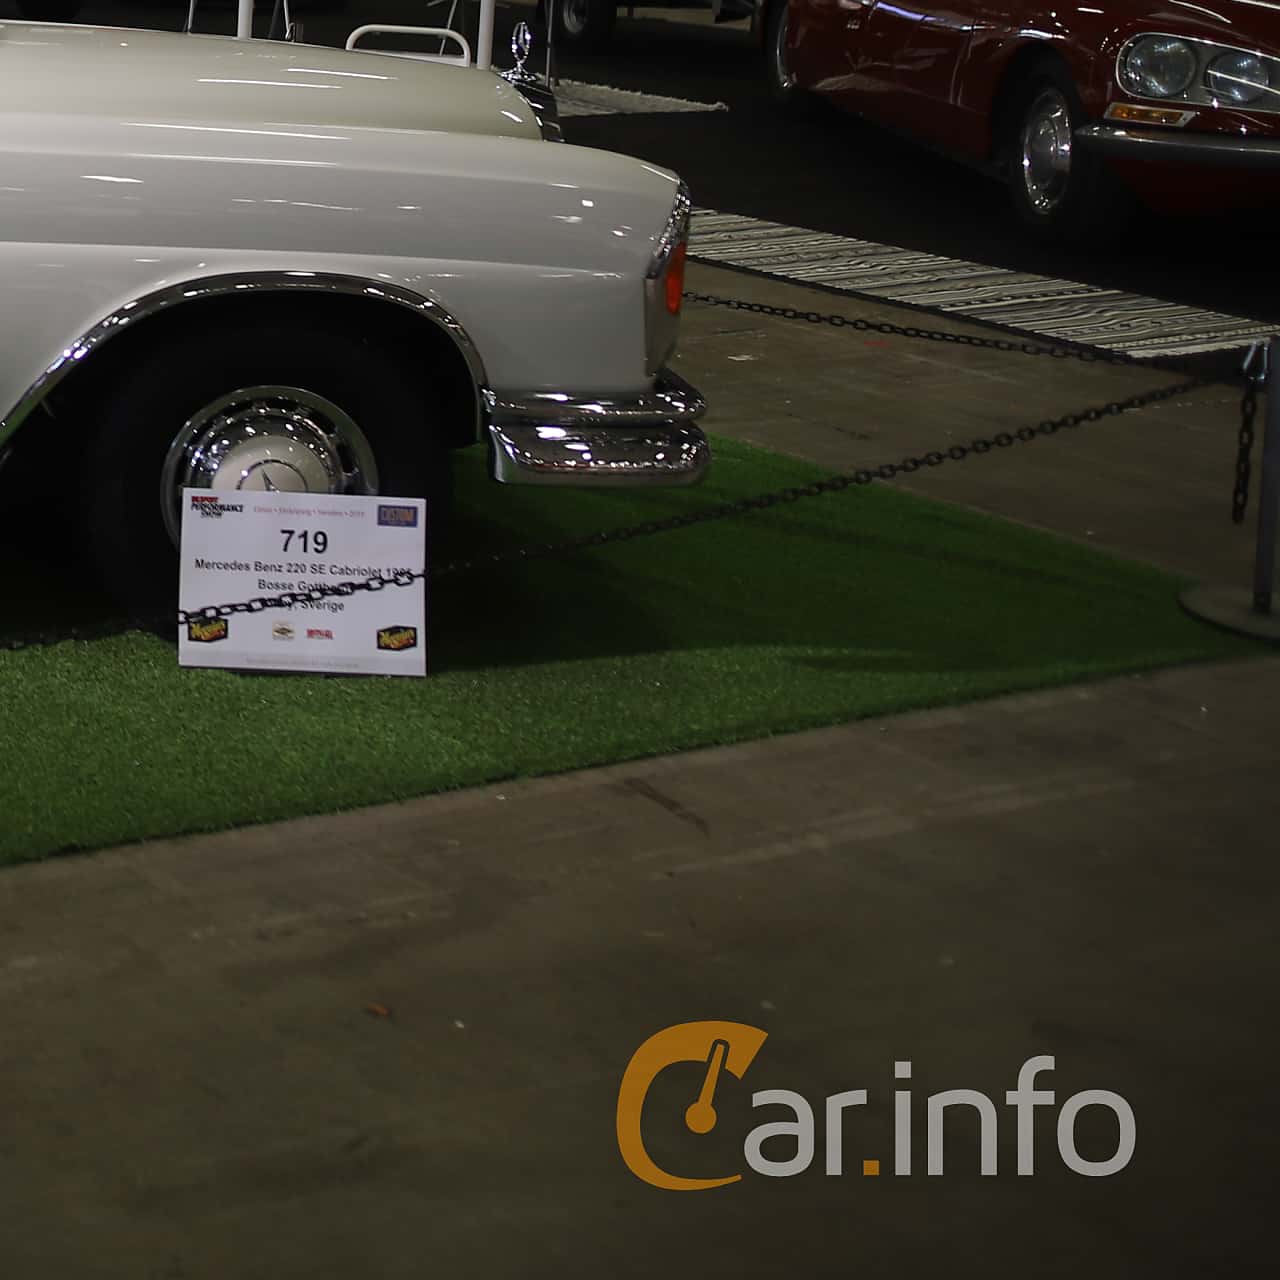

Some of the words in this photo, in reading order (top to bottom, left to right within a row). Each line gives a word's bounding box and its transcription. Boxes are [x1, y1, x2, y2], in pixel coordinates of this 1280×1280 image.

[280, 529, 328, 554] 719
[194, 558, 251, 571] Mercedes
[254, 560, 283, 573] Benz
[286, 563, 307, 574] 220
[310, 564, 327, 575] SE
[329, 566, 382, 578] Cabriolet
[258, 579, 294, 592] Bosse
